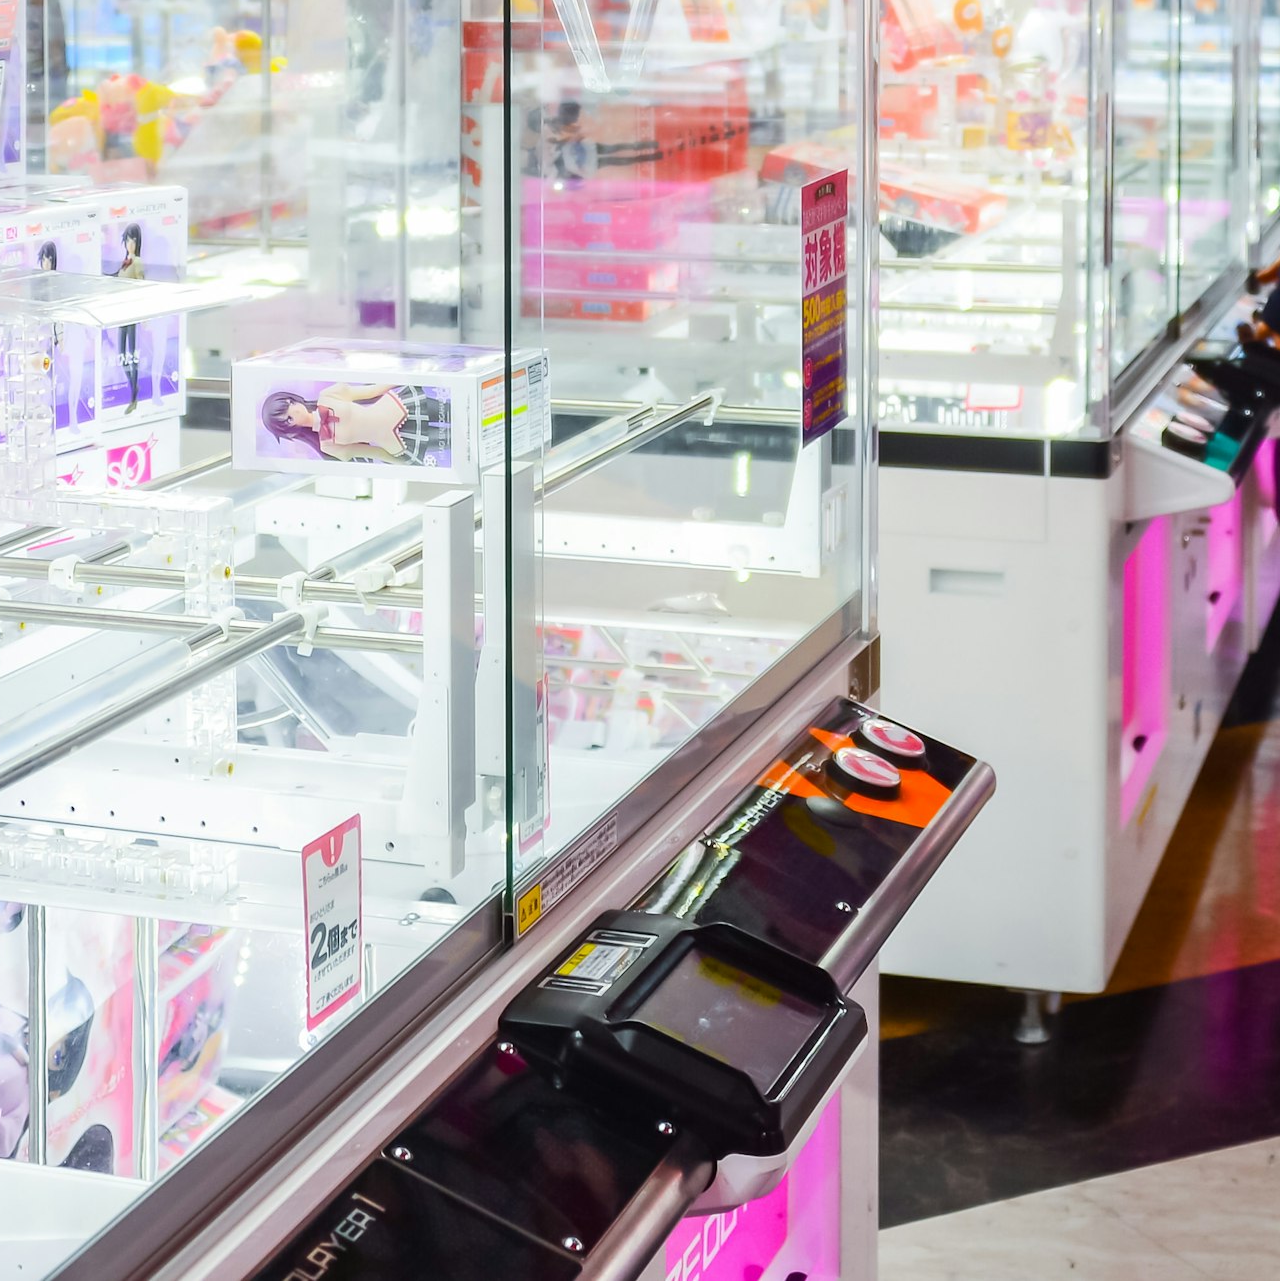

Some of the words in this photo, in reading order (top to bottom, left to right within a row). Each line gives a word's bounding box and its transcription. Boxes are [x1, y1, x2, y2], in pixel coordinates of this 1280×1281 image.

[804, 219, 846, 290] 対象機
[310, 918, 358, 970] 2個まで
